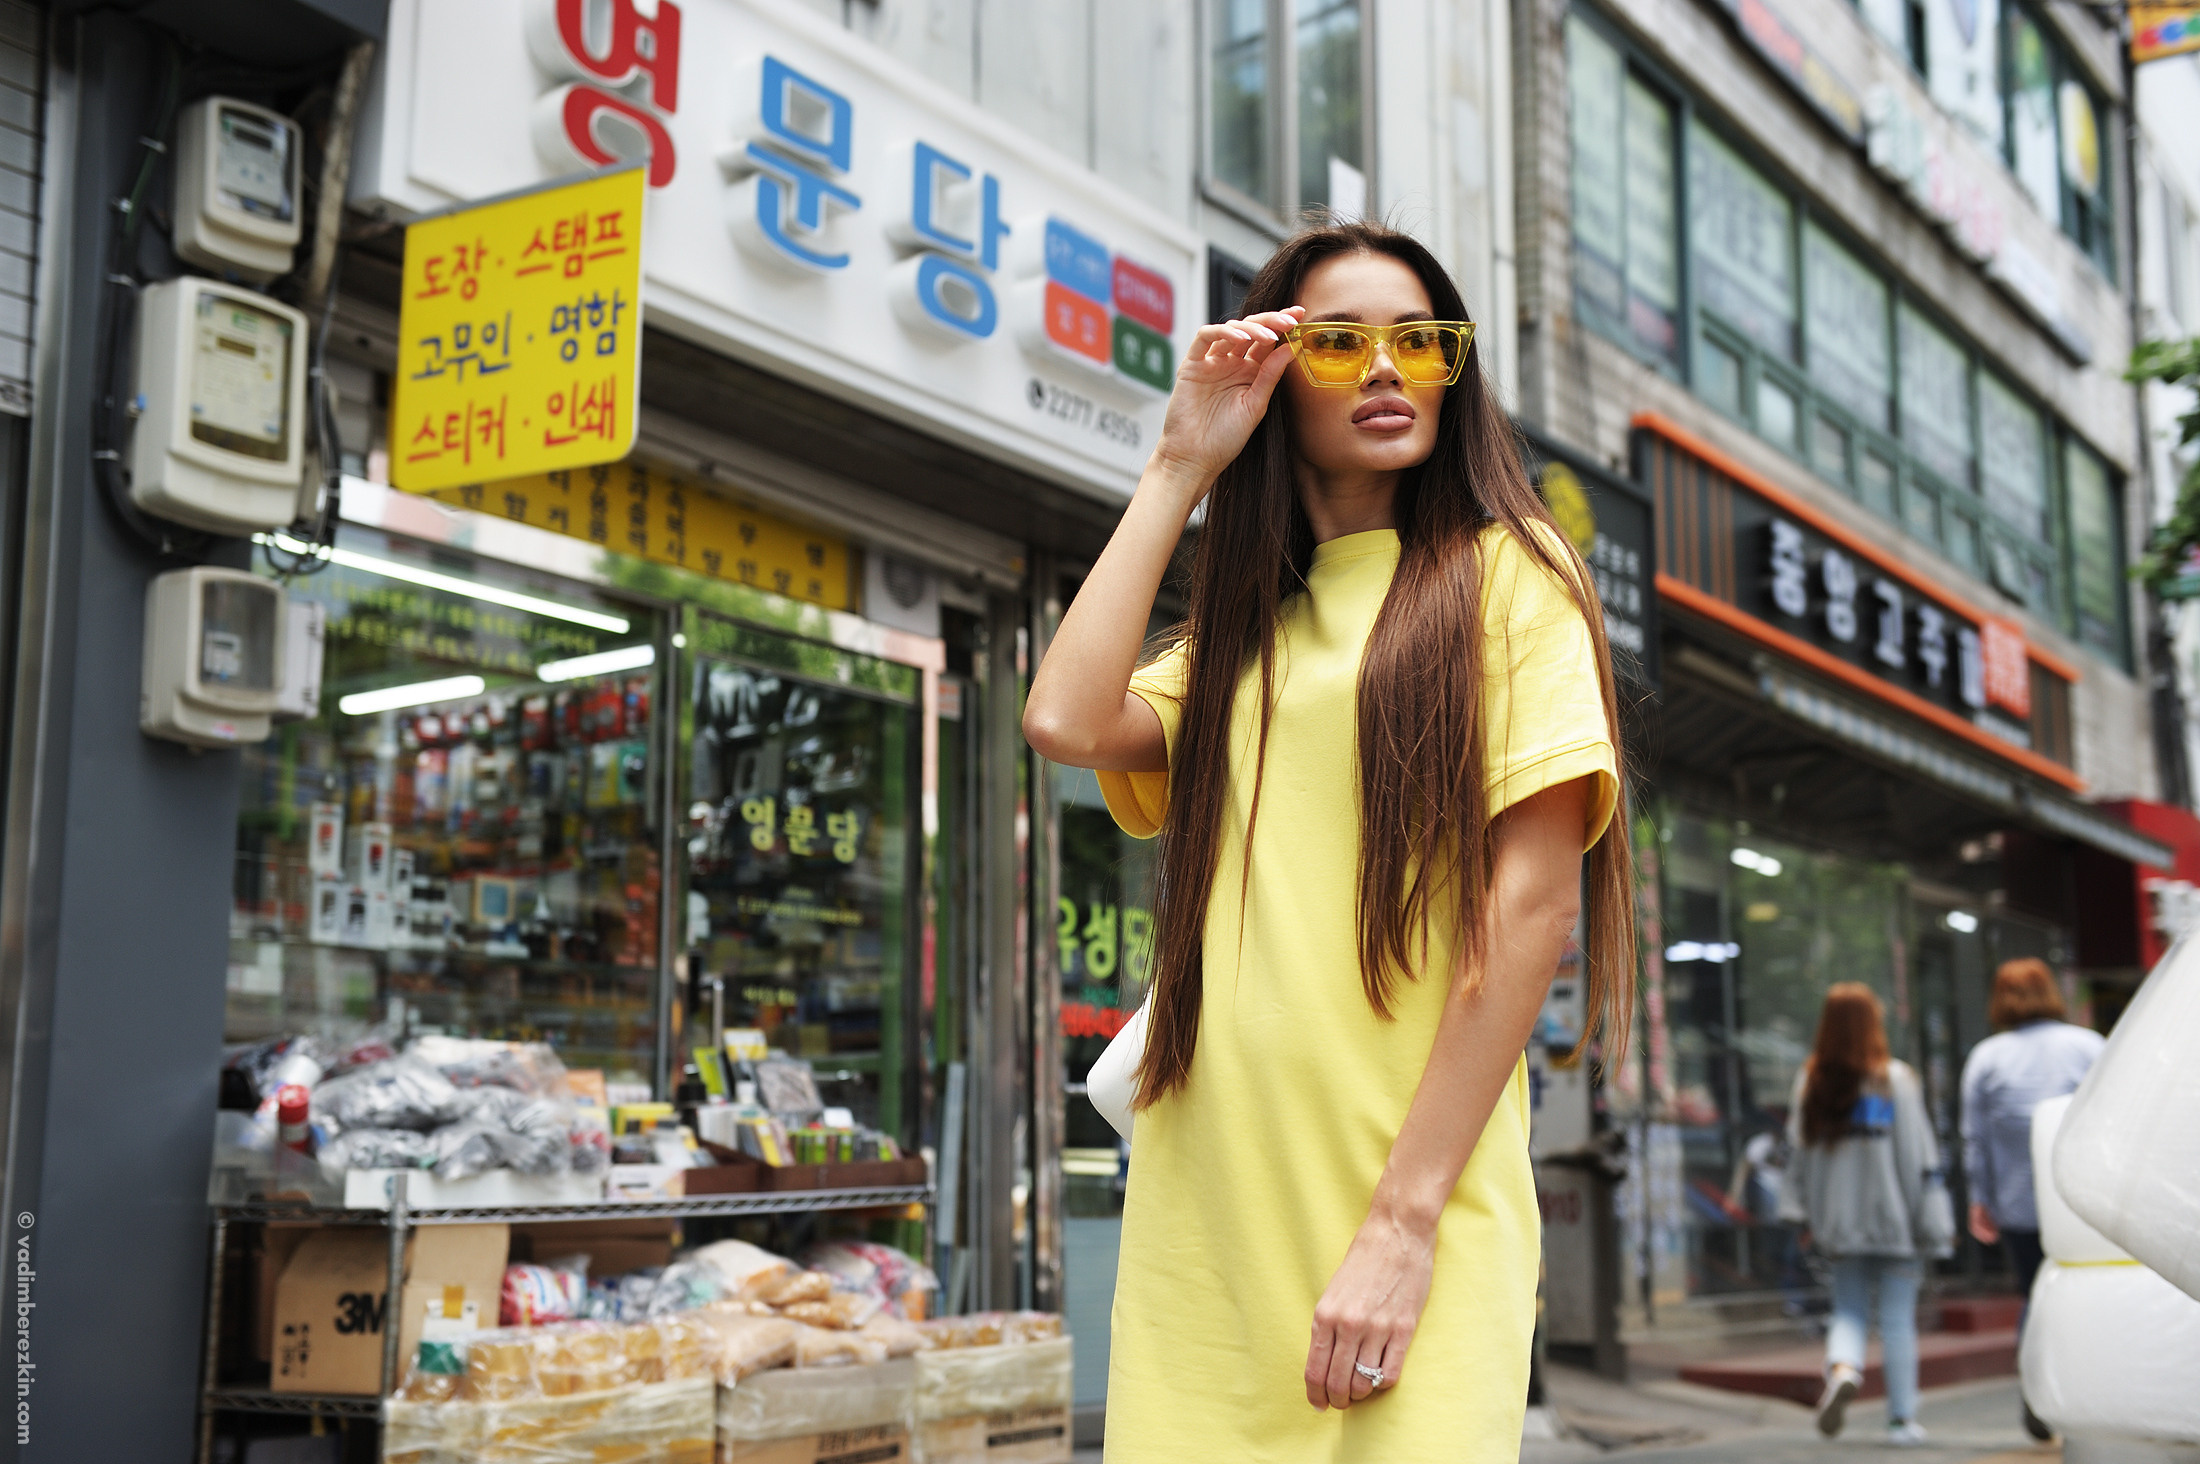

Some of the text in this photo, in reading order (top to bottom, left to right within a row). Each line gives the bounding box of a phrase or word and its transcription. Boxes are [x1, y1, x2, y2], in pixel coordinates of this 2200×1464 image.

[556, 0, 1010, 338] 영문당
[415, 210, 627, 300] 도장 스탬프
[411, 287, 628, 384] 고무인 명함
[406, 373, 616, 465] 스티커 인쇄
[741, 796, 860, 863] 영문당
[334, 1292, 389, 1335] 3M
